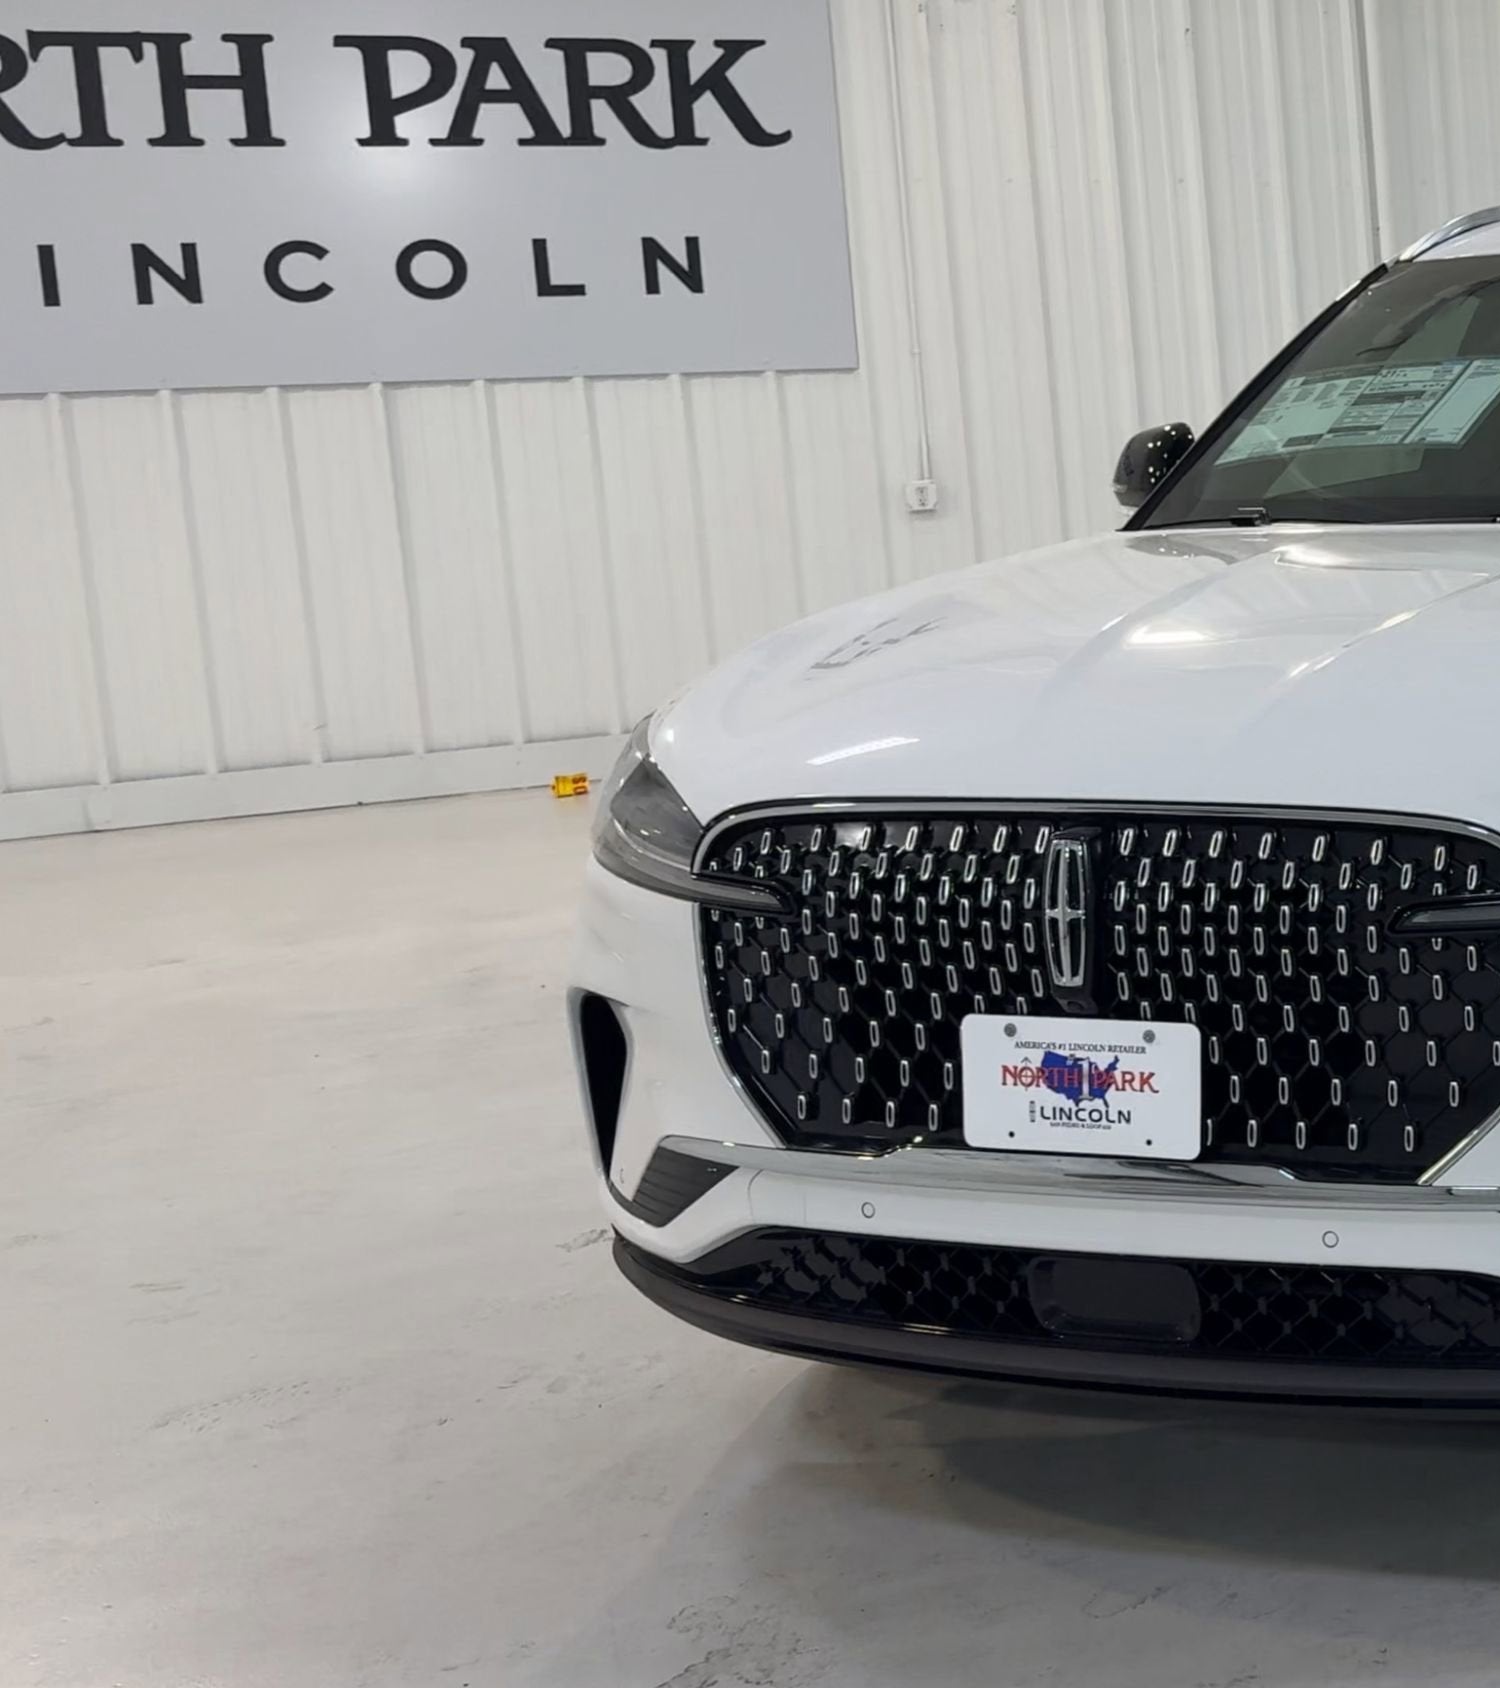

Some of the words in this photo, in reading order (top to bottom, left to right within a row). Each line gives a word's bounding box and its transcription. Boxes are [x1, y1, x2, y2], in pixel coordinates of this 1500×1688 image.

[333, 34, 792, 149] PARK
[36, 236, 704, 307] INCOLN
[1014, 1040, 1057, 1051] AMERICA'S
[1068, 1042, 1106, 1053] LINCOLN
[1107, 1044, 1147, 1055] RETAILER
[1001, 1065, 1079, 1088] NORTH
[1093, 1069, 1160, 1094] PARK
[1040, 1105, 1131, 1124] LINCOLN
